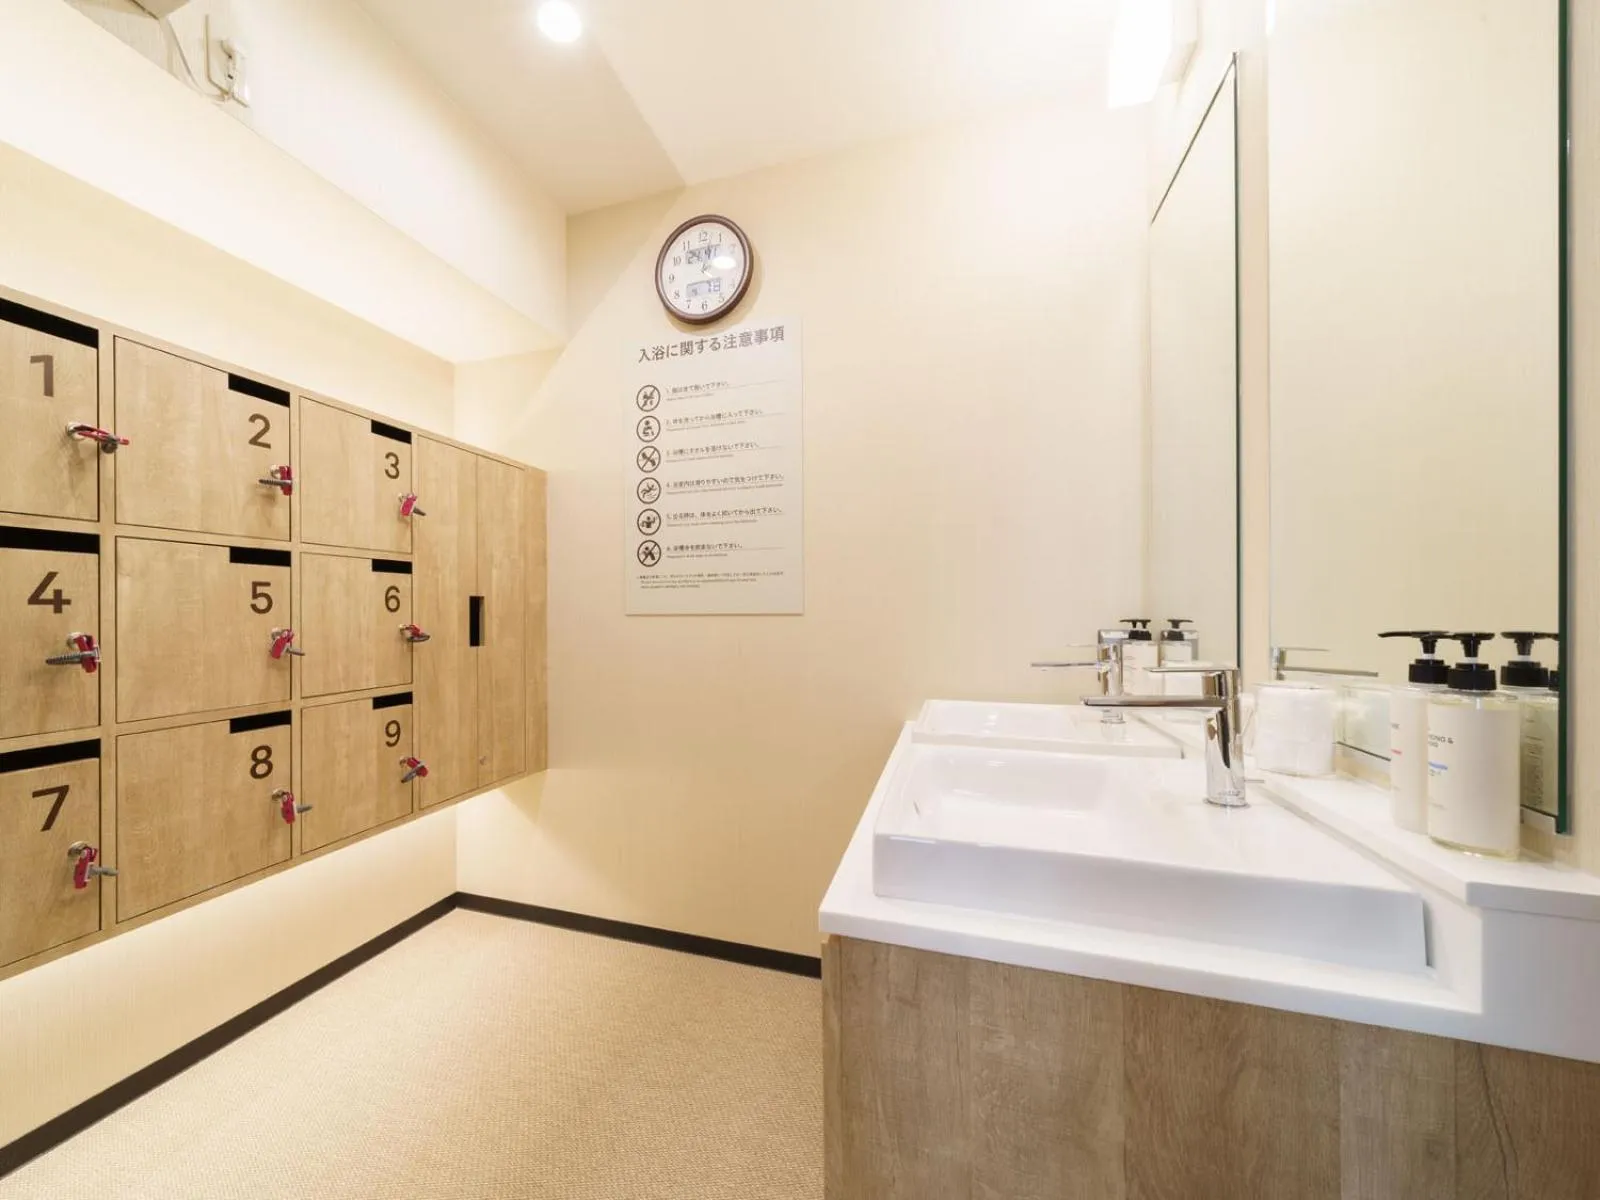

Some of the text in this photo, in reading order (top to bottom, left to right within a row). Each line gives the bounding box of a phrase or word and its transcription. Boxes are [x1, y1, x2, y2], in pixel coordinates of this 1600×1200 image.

[638, 325, 785, 362] 入浴に関する注意事項
[30, 355, 54, 397] 1
[248, 413, 271, 448] 2
[384, 452, 400, 480] 3
[27, 571, 71, 614] 4
[250, 582, 273, 614] 5
[384, 585, 400, 613] 6
[385, 720, 401, 748] 9
[250, 745, 273, 779] 8
[31, 785, 70, 831] 7
